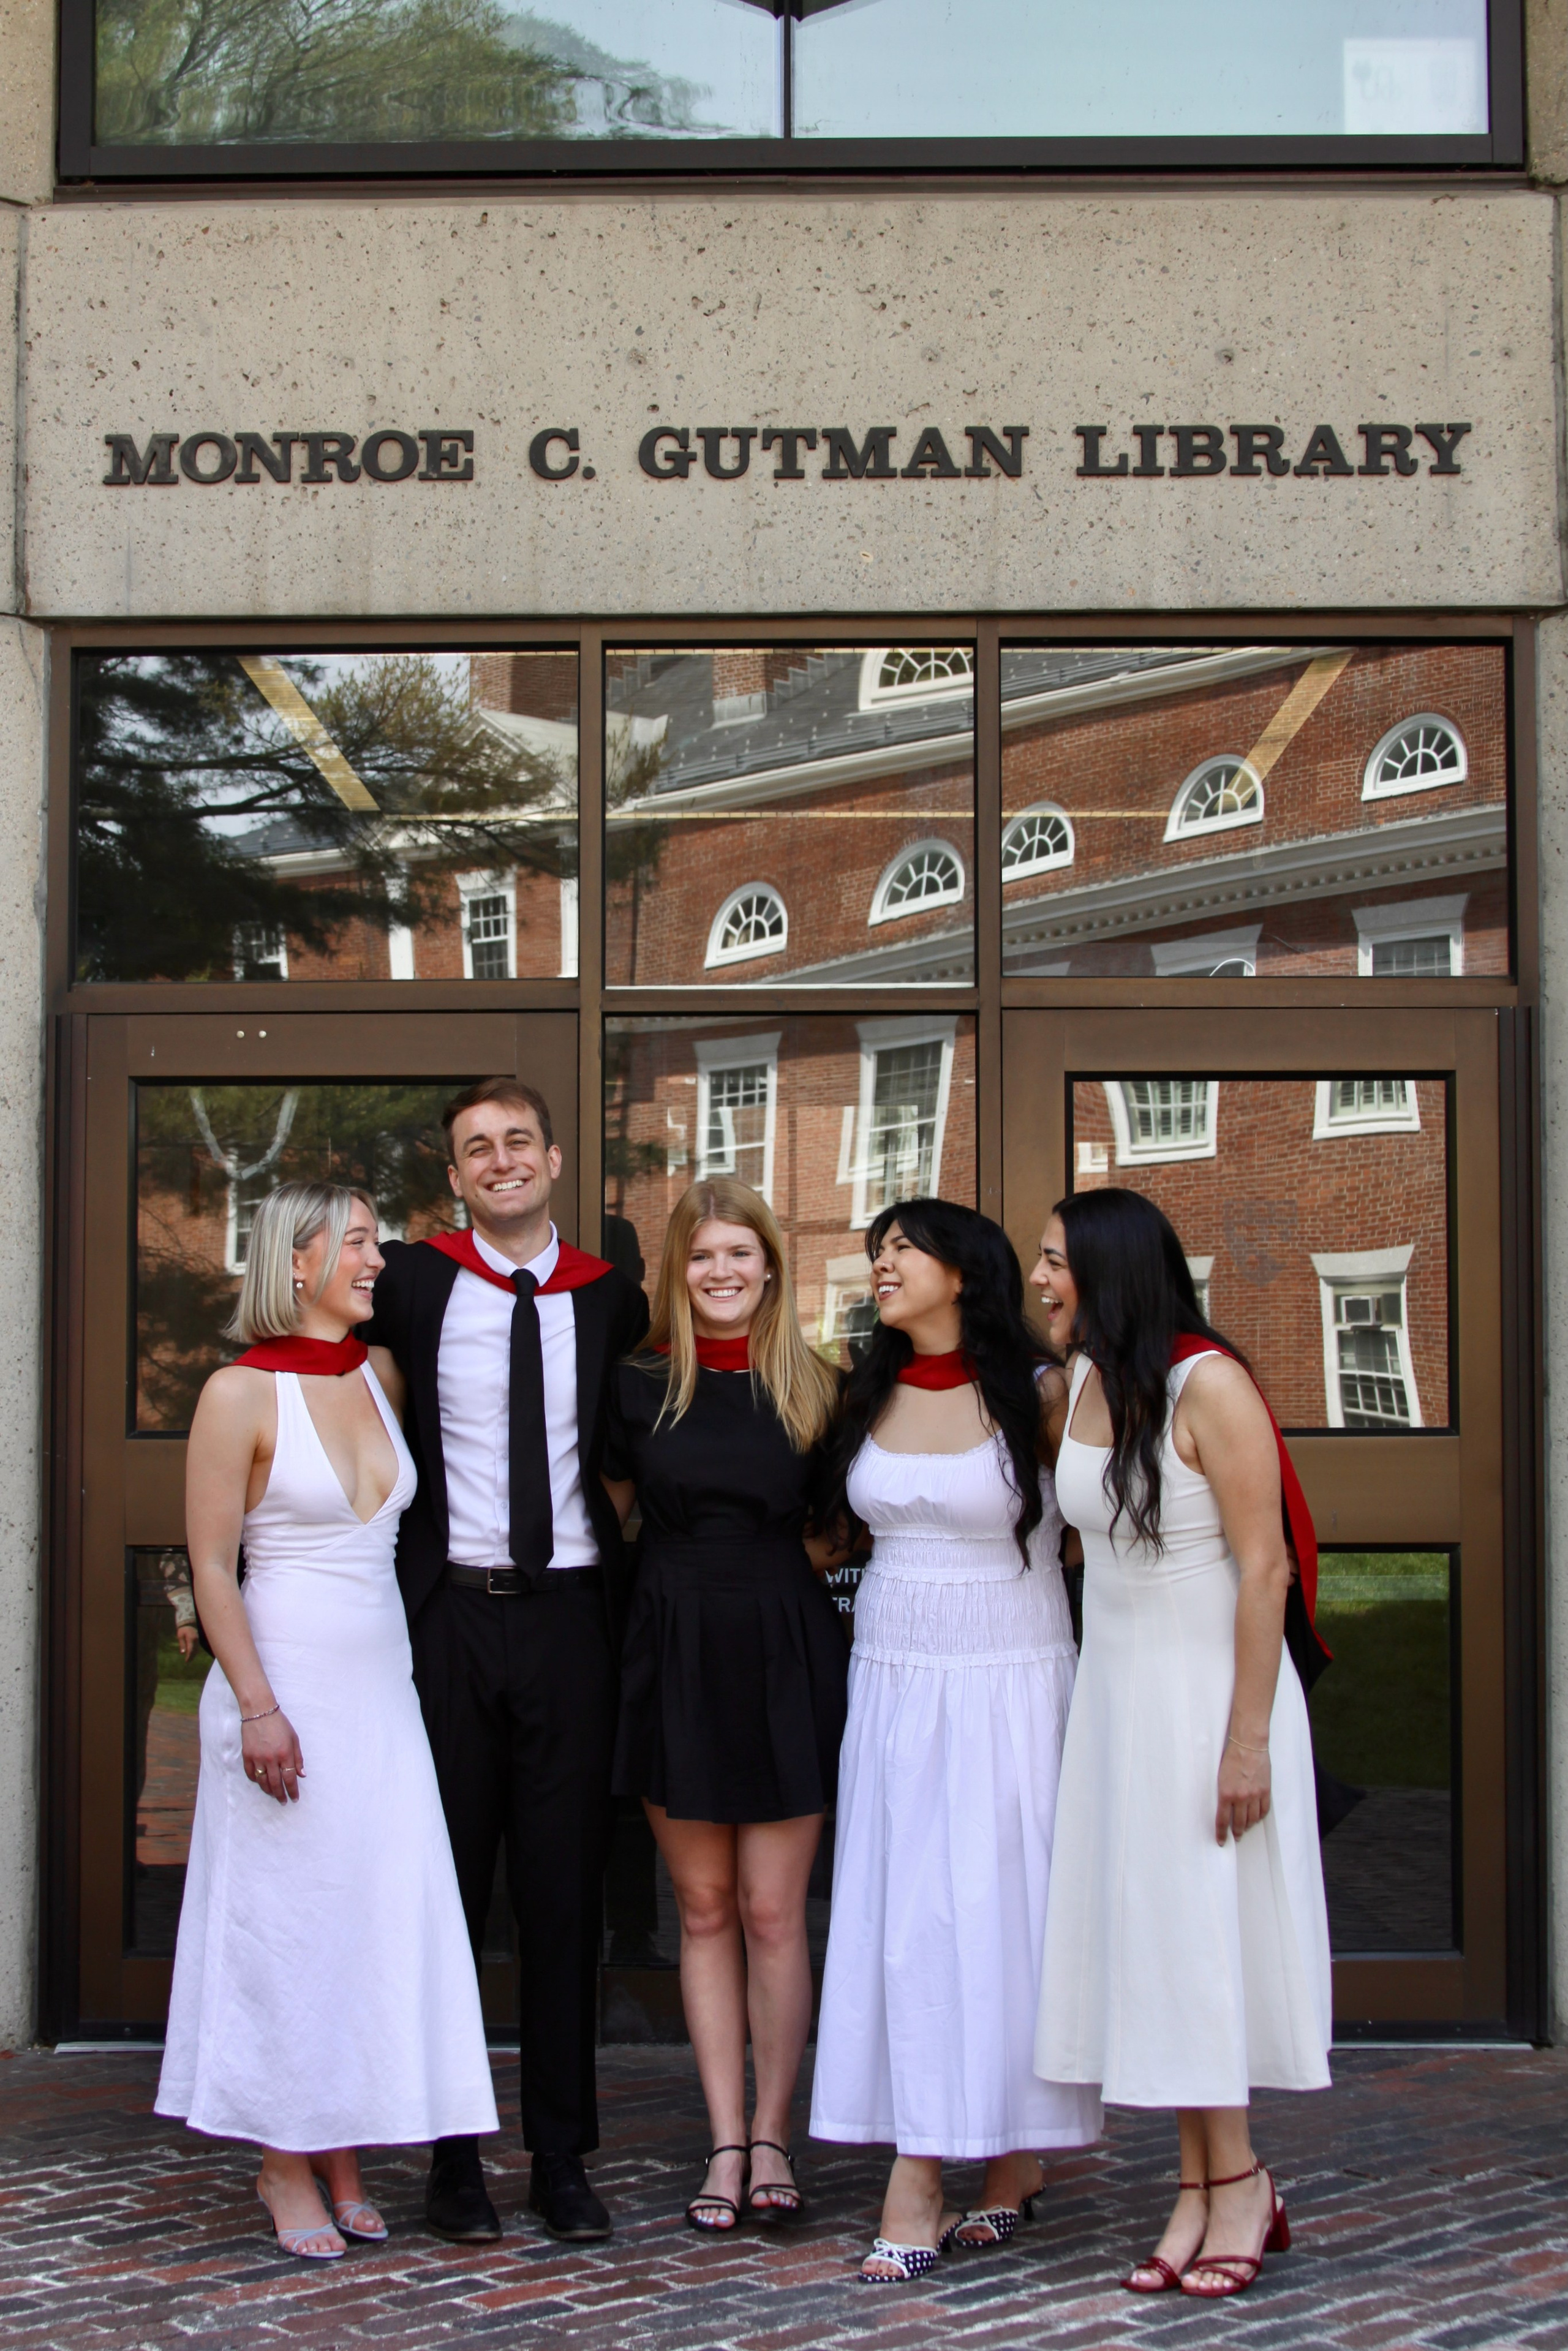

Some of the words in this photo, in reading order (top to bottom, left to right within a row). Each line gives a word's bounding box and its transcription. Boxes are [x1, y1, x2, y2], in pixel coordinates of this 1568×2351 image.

[102, 429, 474, 486] MONROE
[529, 428, 596, 481] C.
[638, 426, 1030, 481] GUTMAN
[1074, 421, 1472, 479] LIBRARY
[825, 1568, 865, 1583] WIT
